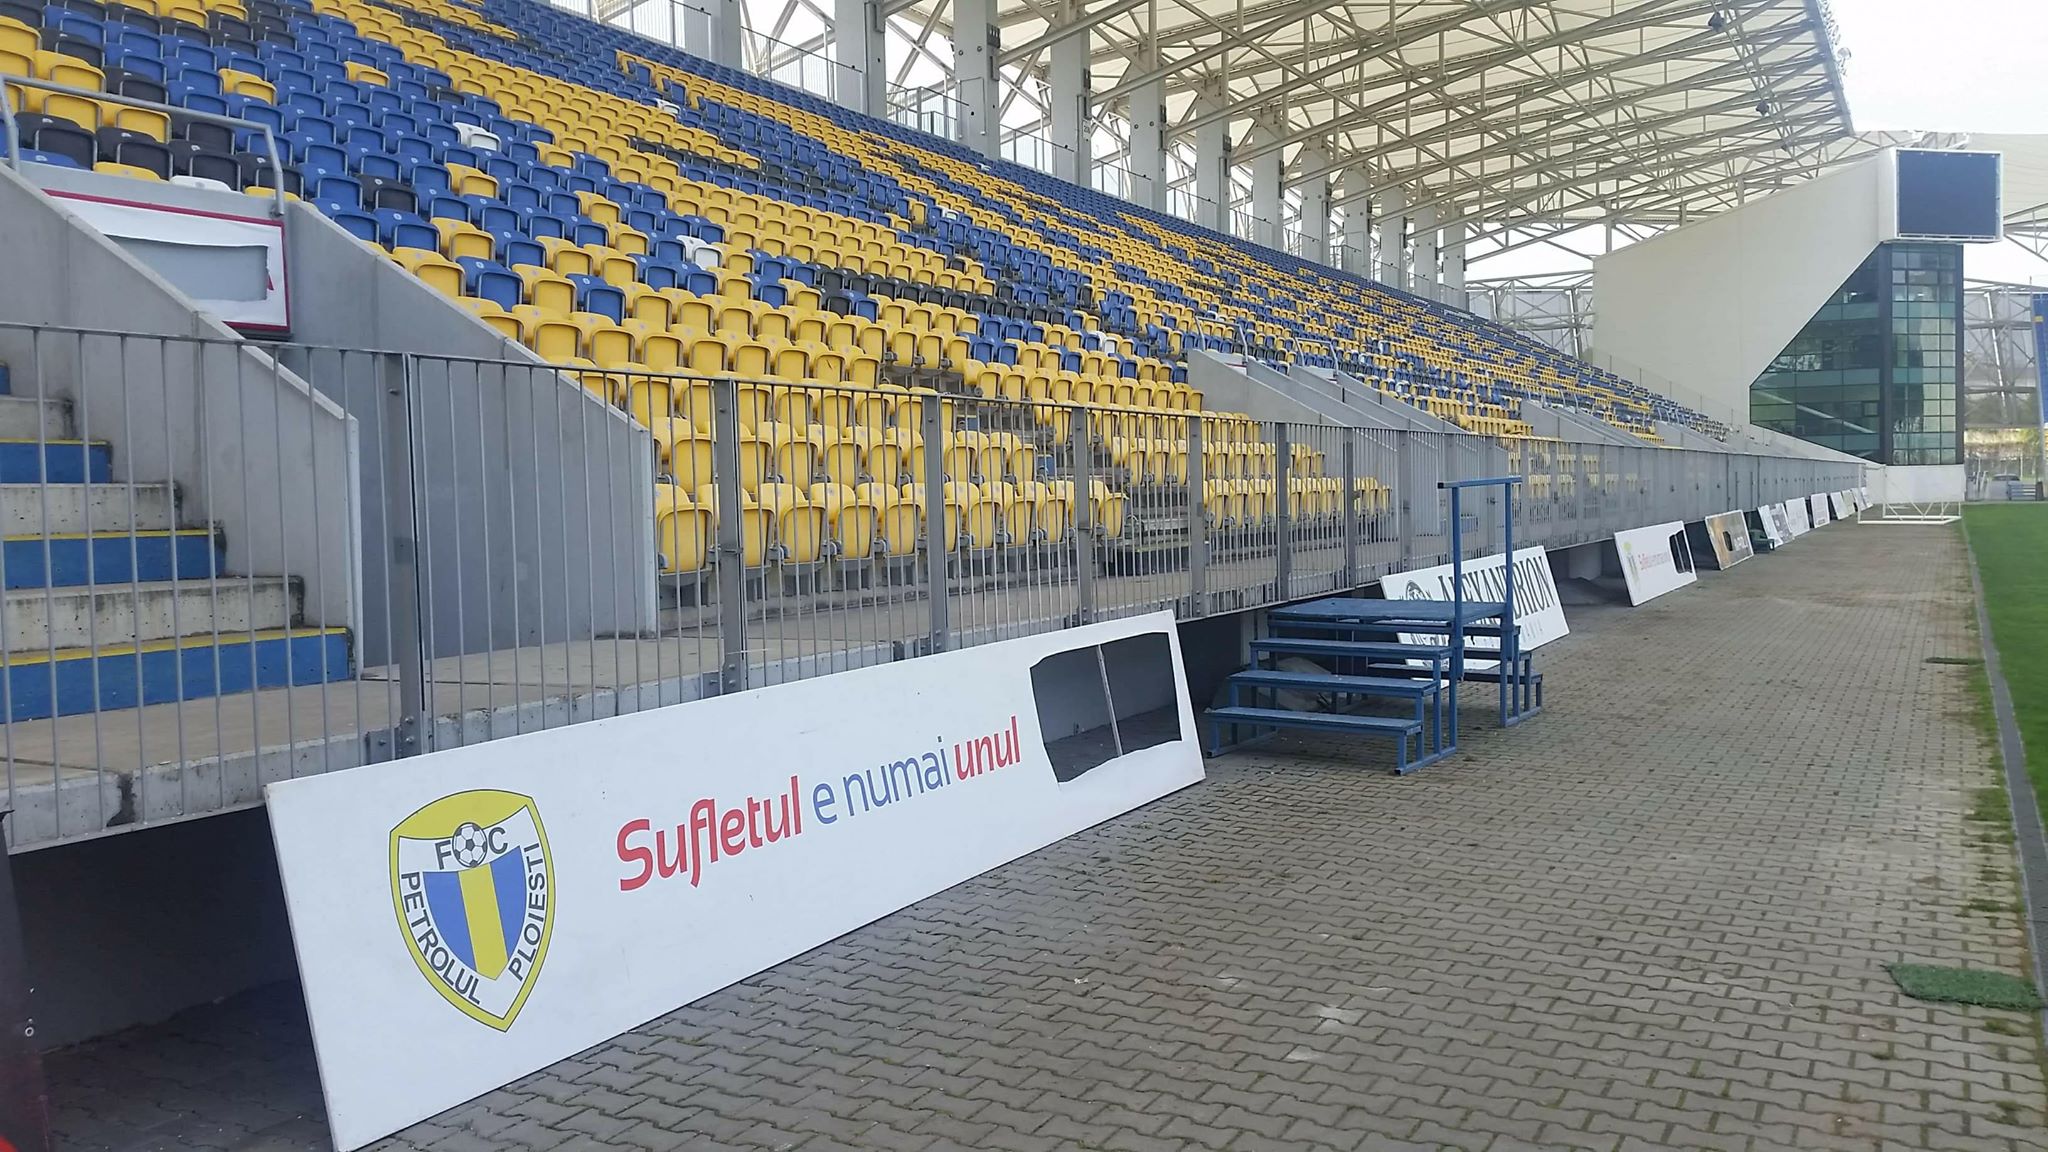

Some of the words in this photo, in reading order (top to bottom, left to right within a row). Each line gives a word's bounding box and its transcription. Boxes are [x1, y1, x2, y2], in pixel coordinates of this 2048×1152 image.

[1438, 556, 1555, 625] AEXANDRION
[617, 775, 802, 890] Sufletul
[813, 782, 838, 824] e
[843, 736, 951, 817] numai
[954, 715, 1021, 781] unul
[401, 871, 481, 1005] PETROLUL
[508, 843, 546, 982] PLOIESTI
